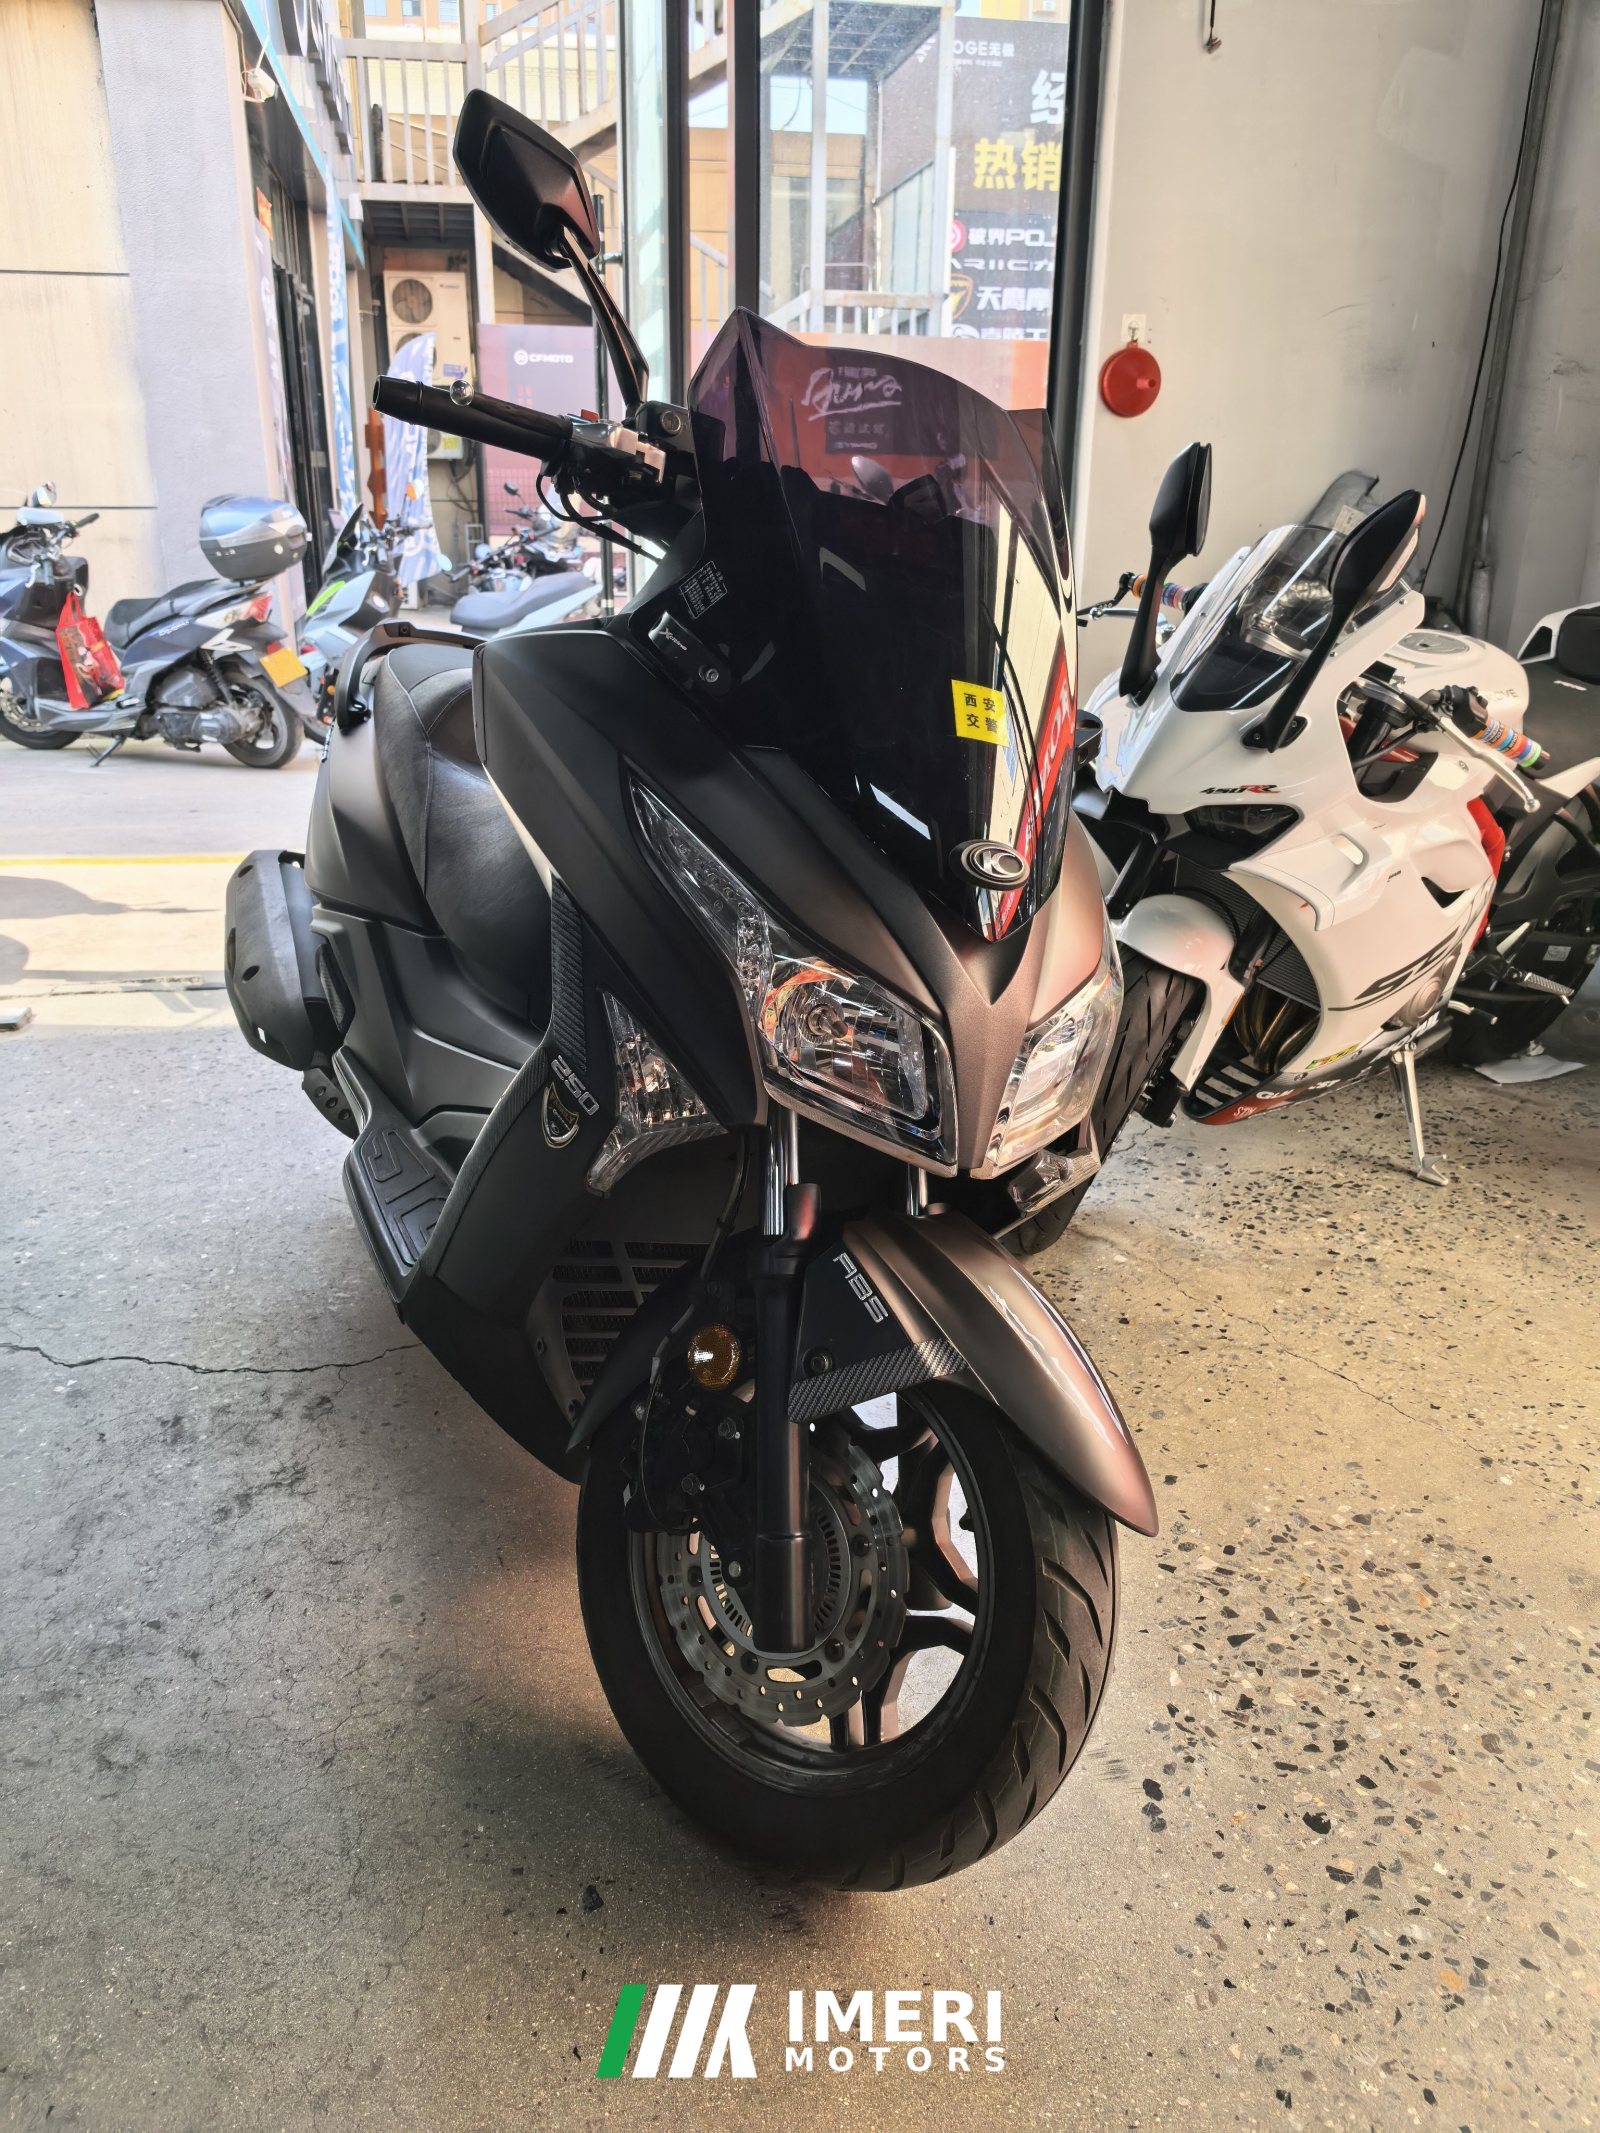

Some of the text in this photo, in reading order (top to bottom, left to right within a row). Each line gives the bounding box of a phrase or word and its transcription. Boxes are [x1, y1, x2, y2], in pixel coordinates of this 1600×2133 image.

[963, 692, 996, 713] 西安
[966, 713, 998, 733] 交警
[550, 1054, 600, 1116] 250
[832, 1252, 889, 1323] ABS
